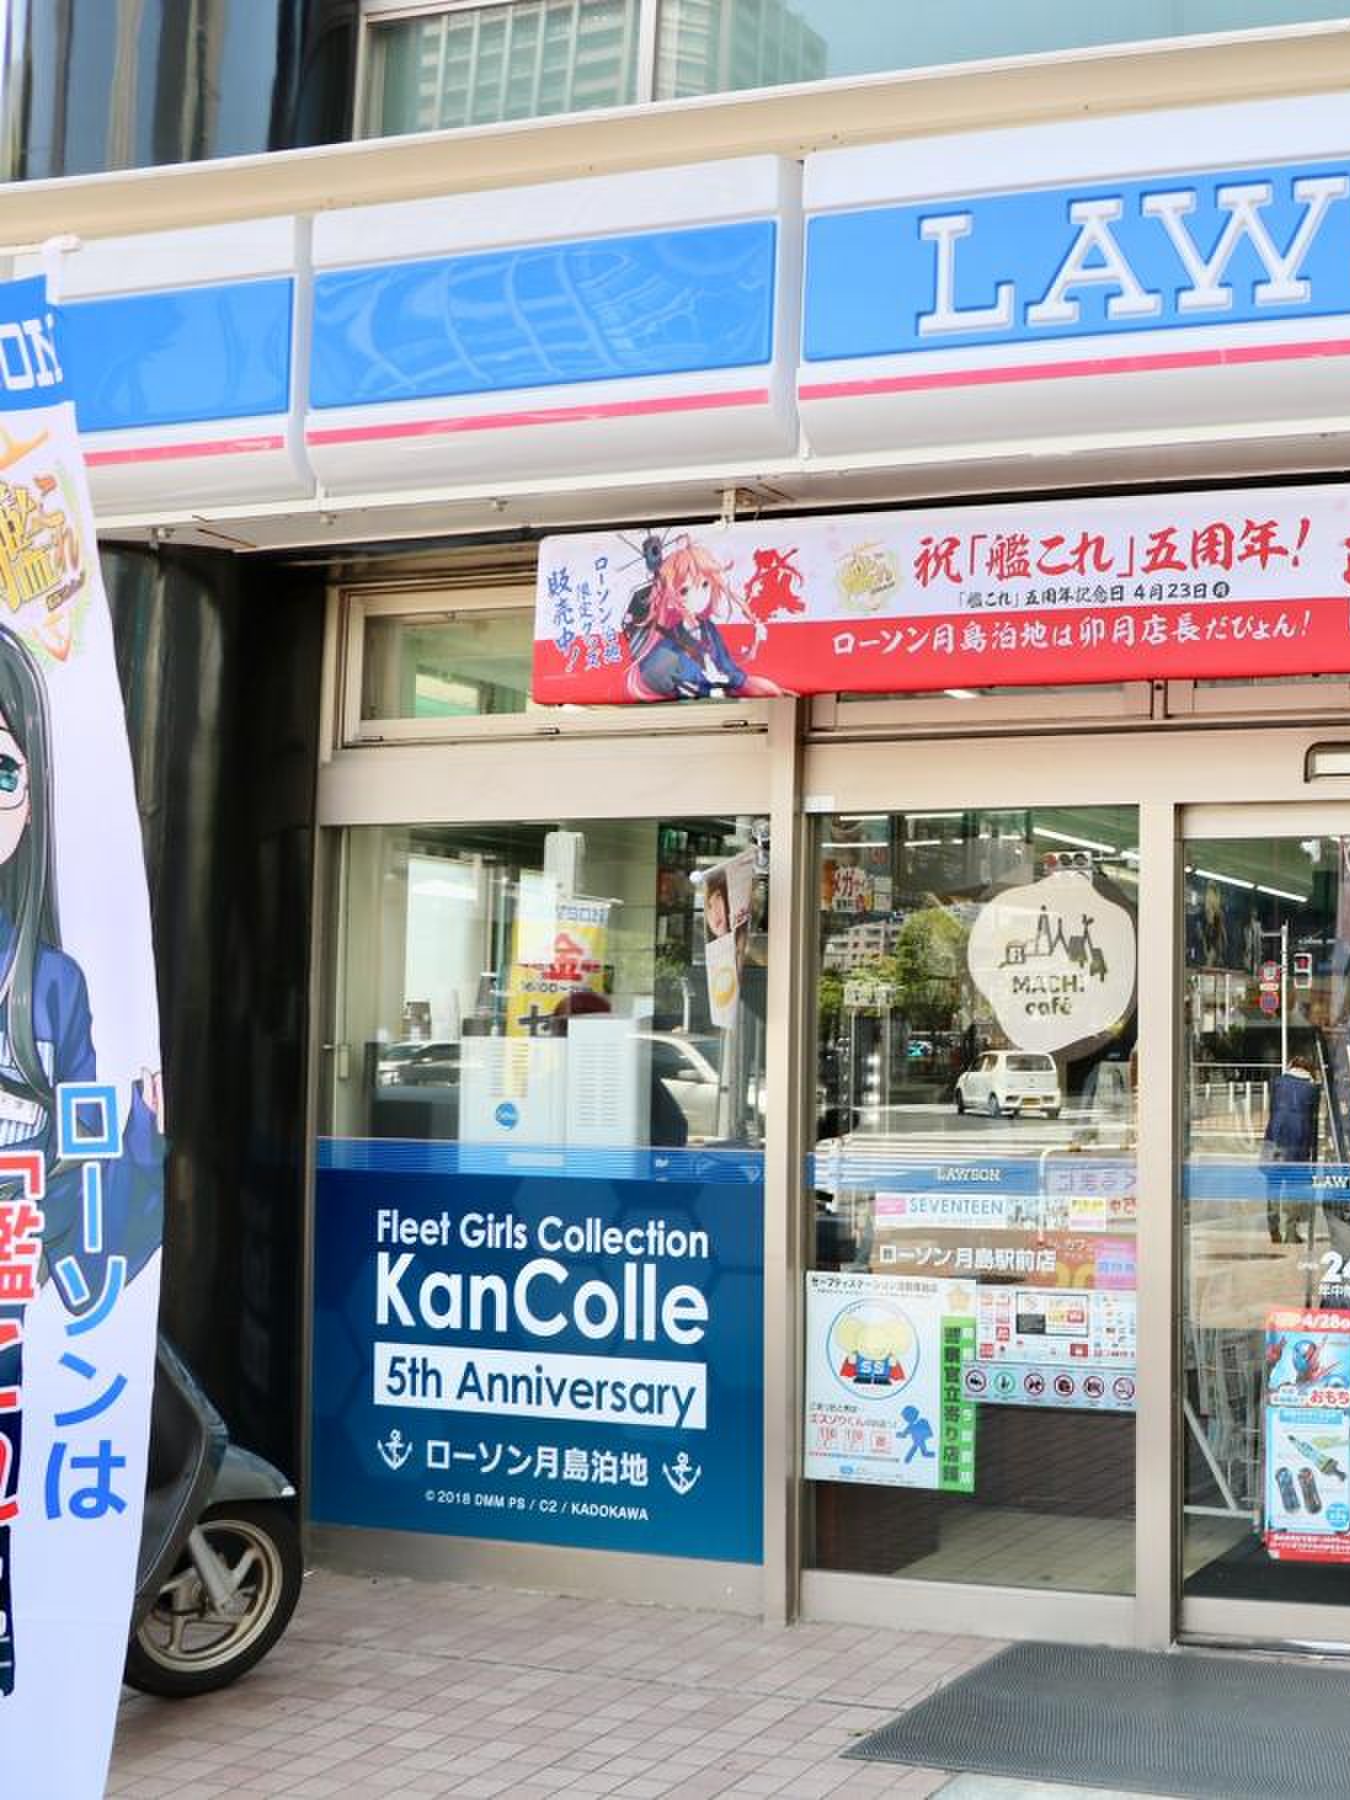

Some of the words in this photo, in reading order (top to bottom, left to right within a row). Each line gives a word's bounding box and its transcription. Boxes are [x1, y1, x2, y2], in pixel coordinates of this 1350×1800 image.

[937, 1167, 1000, 1182] LAWSON
[909, 1197, 1004, 1216] SEVENTEEN
[376, 1209, 450, 1245] Fleet
[460, 1213, 528, 1250] Girls
[537, 1215, 709, 1258] Collection
[45, 1082, 128, 1521] ローソンは
[375, 1252, 709, 1345] KanColle
[386, 1356, 442, 1400] 5th
[456, 1360, 697, 1428] Anniversary
[426, 1439, 649, 1487] ローソン月島泊地
[474, 1493, 505, 1508] DMM
[509, 1495, 526, 1511] PS
[538, 1498, 558, 1513] C2
[571, 1502, 650, 1522] KADOKAWA
